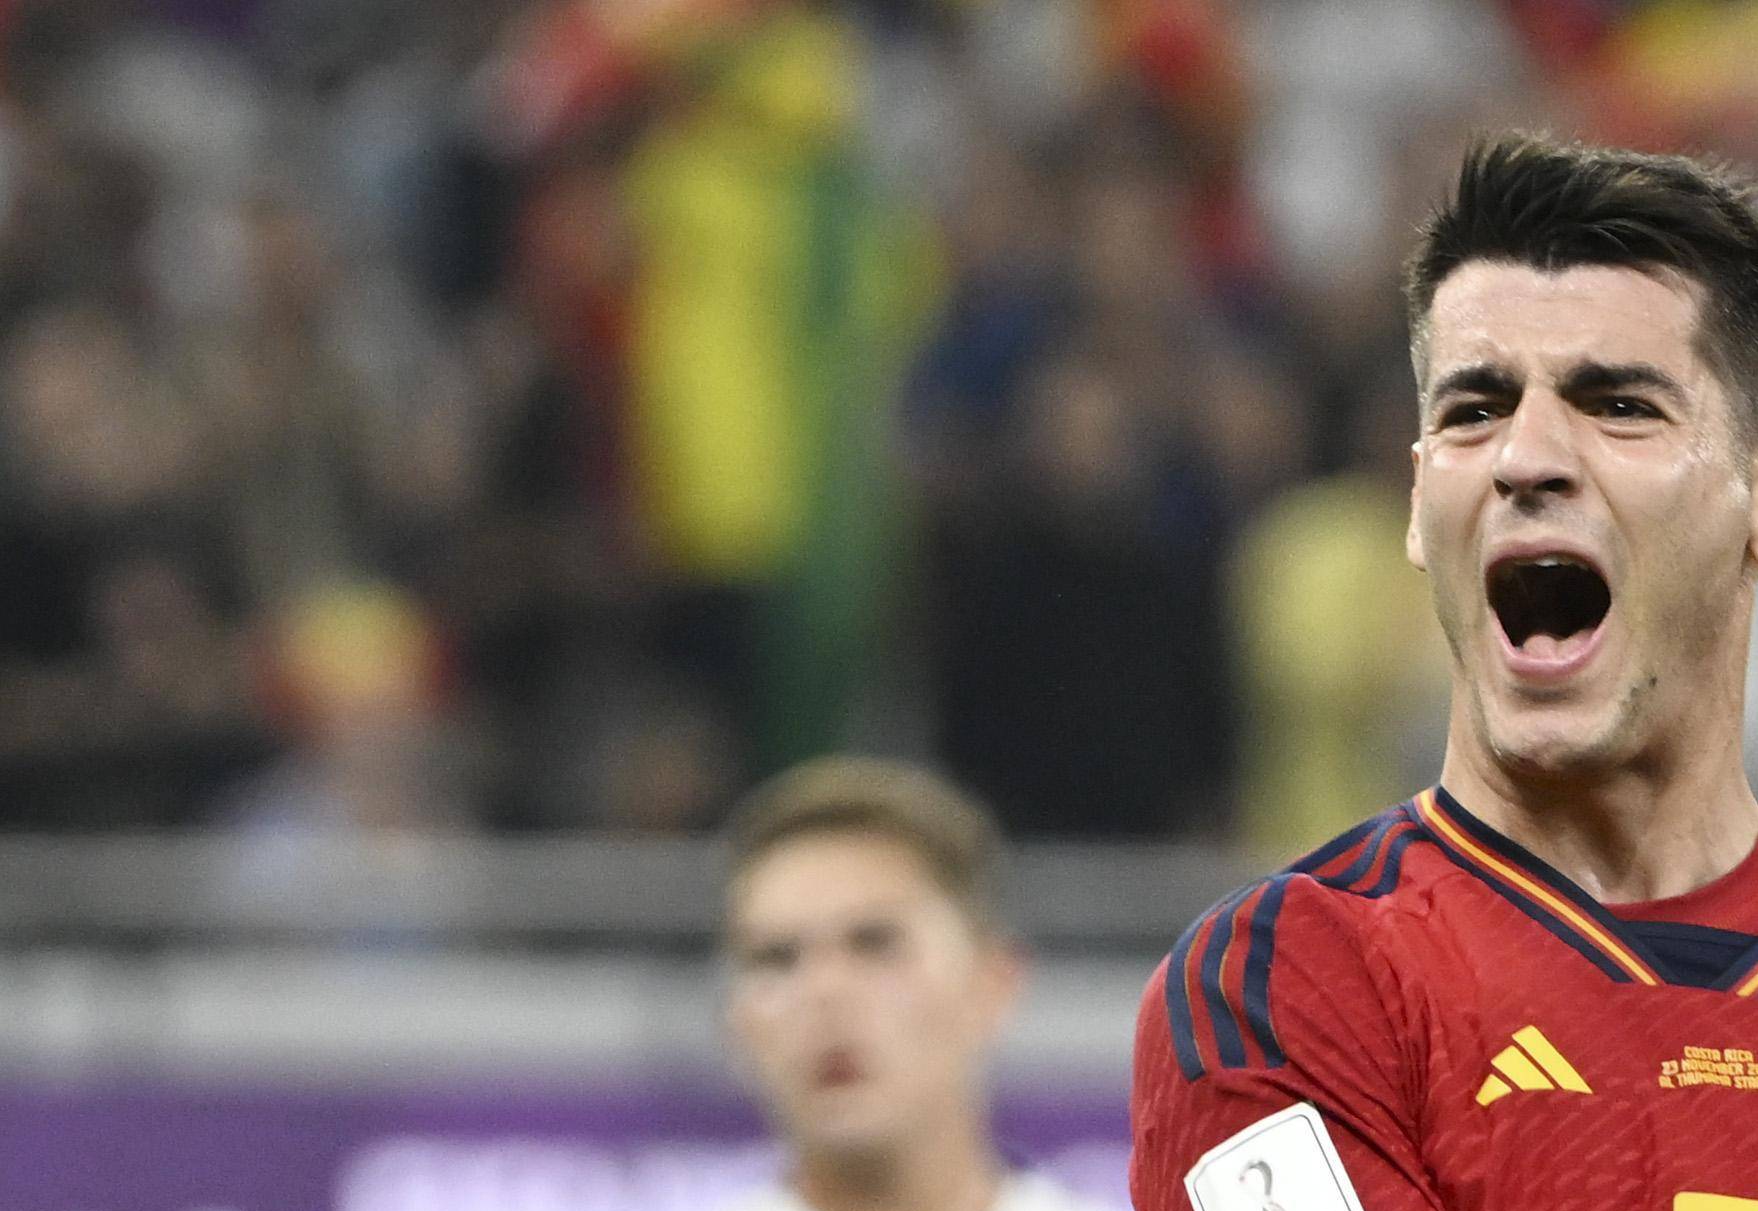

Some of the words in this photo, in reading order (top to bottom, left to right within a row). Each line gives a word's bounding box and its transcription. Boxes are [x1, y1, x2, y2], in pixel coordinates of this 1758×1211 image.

[1684, 1045, 1720, 1061] COSTA
[1724, 1048, 1754, 1063] RICA
[1681, 1058, 1744, 1076] NOVEMBER
